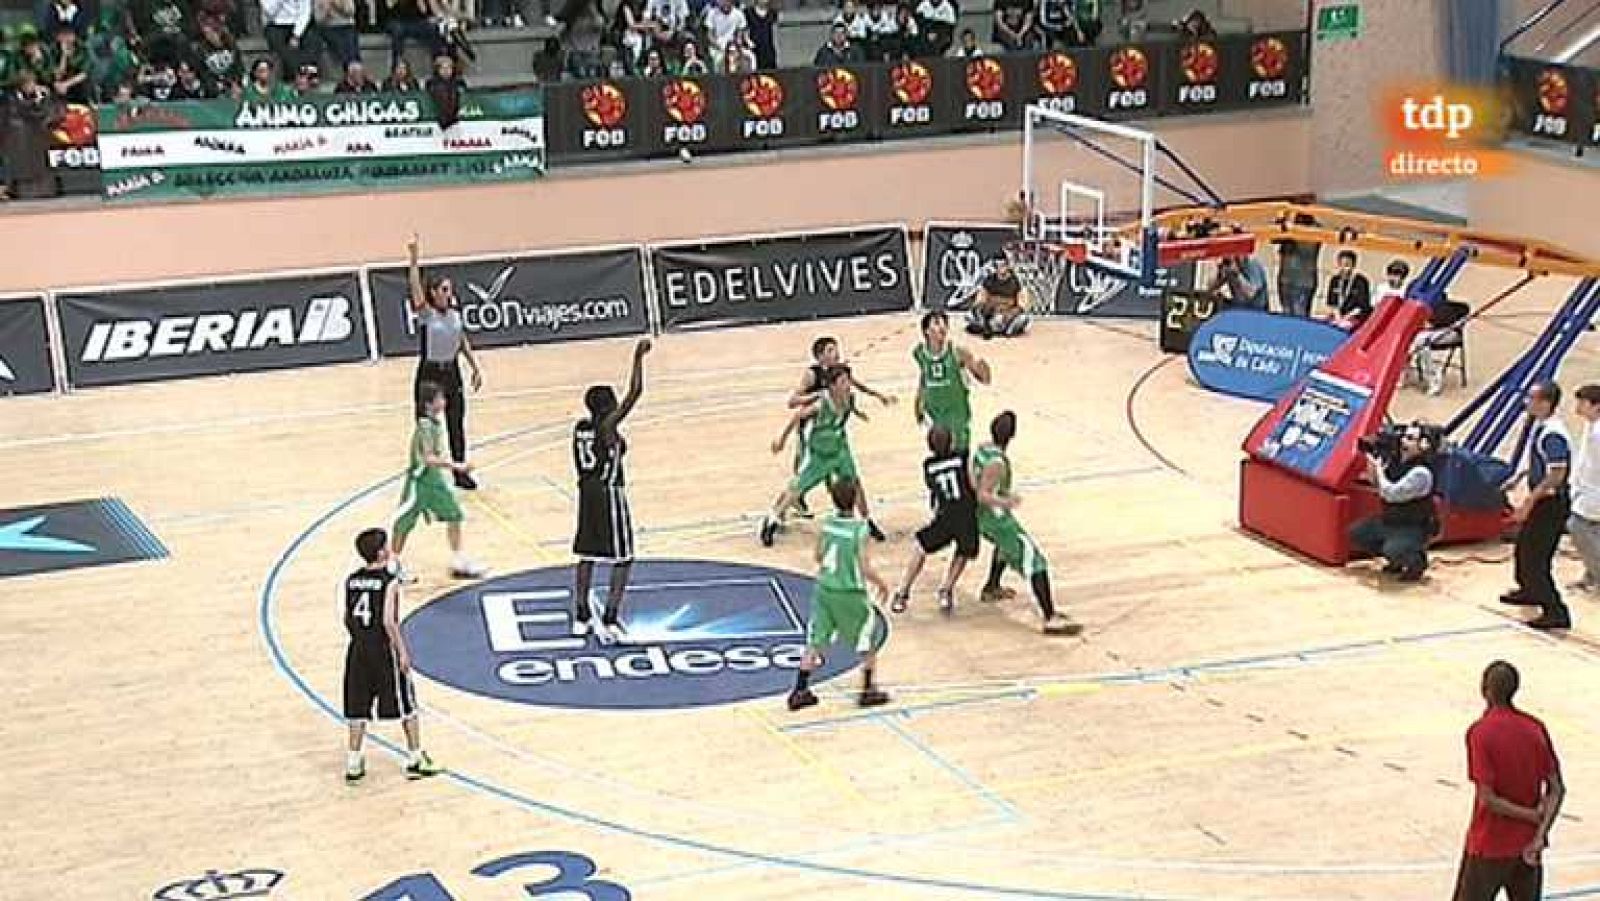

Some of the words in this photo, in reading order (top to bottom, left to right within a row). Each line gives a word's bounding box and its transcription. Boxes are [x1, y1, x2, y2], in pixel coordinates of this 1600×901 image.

[325, 100, 420, 123] CHICAS
[665, 253, 899, 306] EDELVIVES
[81, 307, 297, 363] IBERIA
[935, 469, 961, 500] 11
[352, 591, 372, 627] 4
[497, 643, 806, 685] endesa
